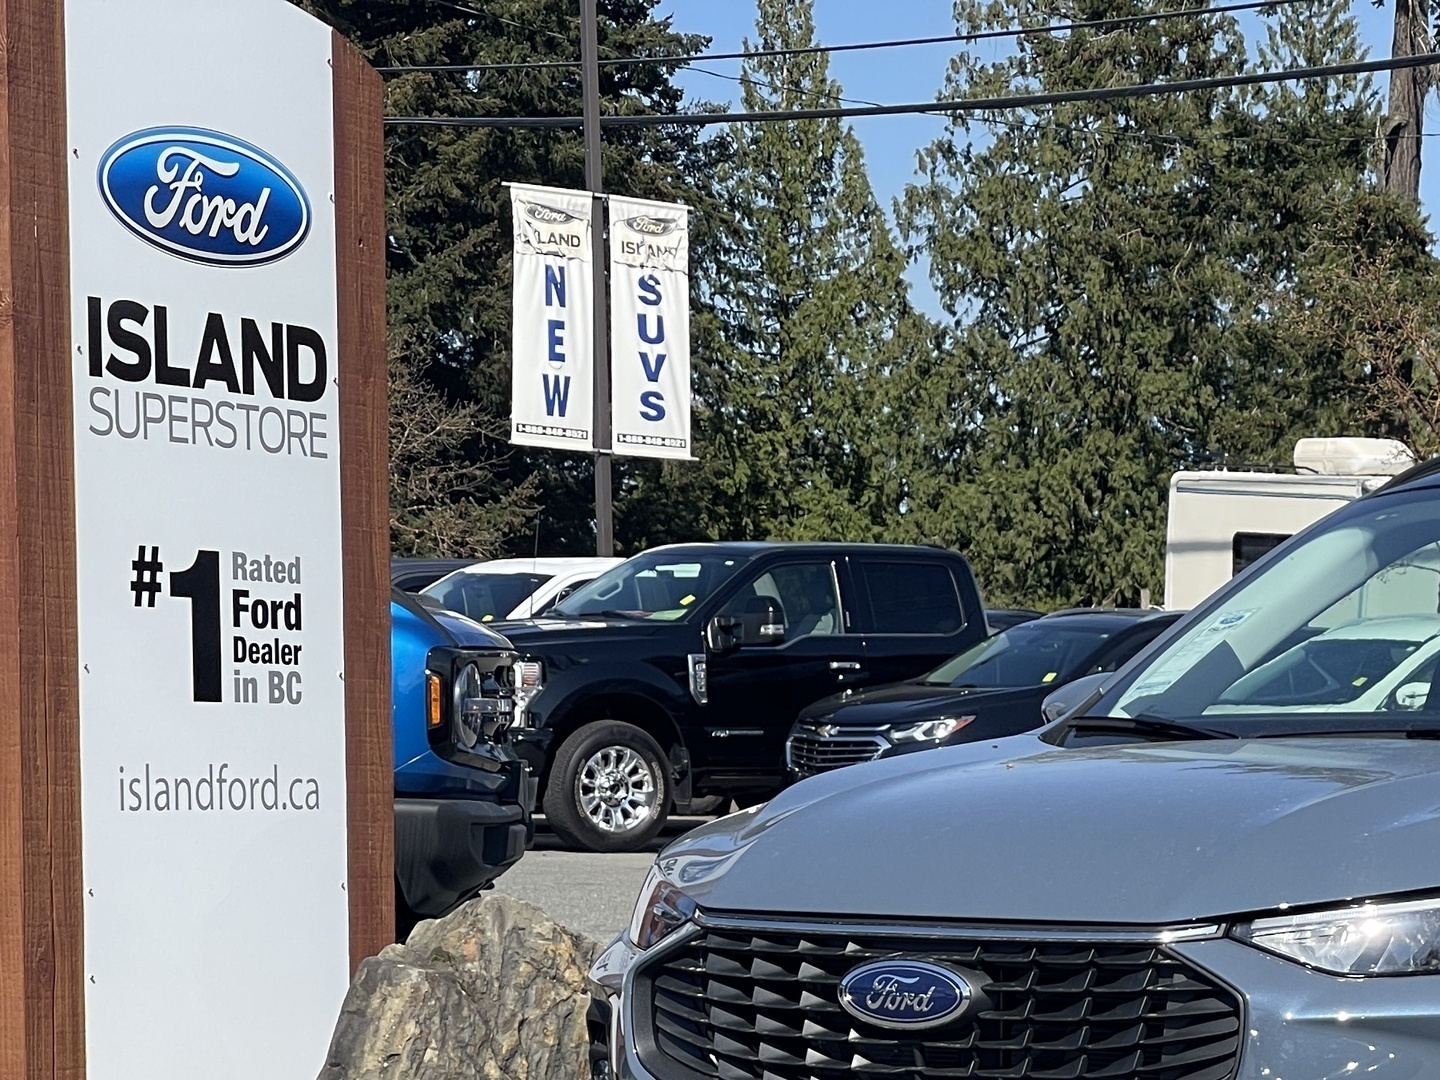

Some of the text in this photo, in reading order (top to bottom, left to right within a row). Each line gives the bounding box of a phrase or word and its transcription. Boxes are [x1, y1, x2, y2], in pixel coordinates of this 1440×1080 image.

[144, 145, 271, 245] Ford
[87, 295, 328, 402] ISLAND
[542, 264, 571, 418] NEW
[637, 274, 667, 422] SUVS
[88, 386, 328, 459] SUPERSTORE
[232, 551, 302, 584] Rated
[130, 545, 223, 703] #1
[232, 589, 302, 631] Ford
[233, 636, 303, 666] Dealer
[233, 669, 303, 705] in BC
[118, 762, 320, 812] islandford.ca
[866, 974, 936, 1012] Ford
